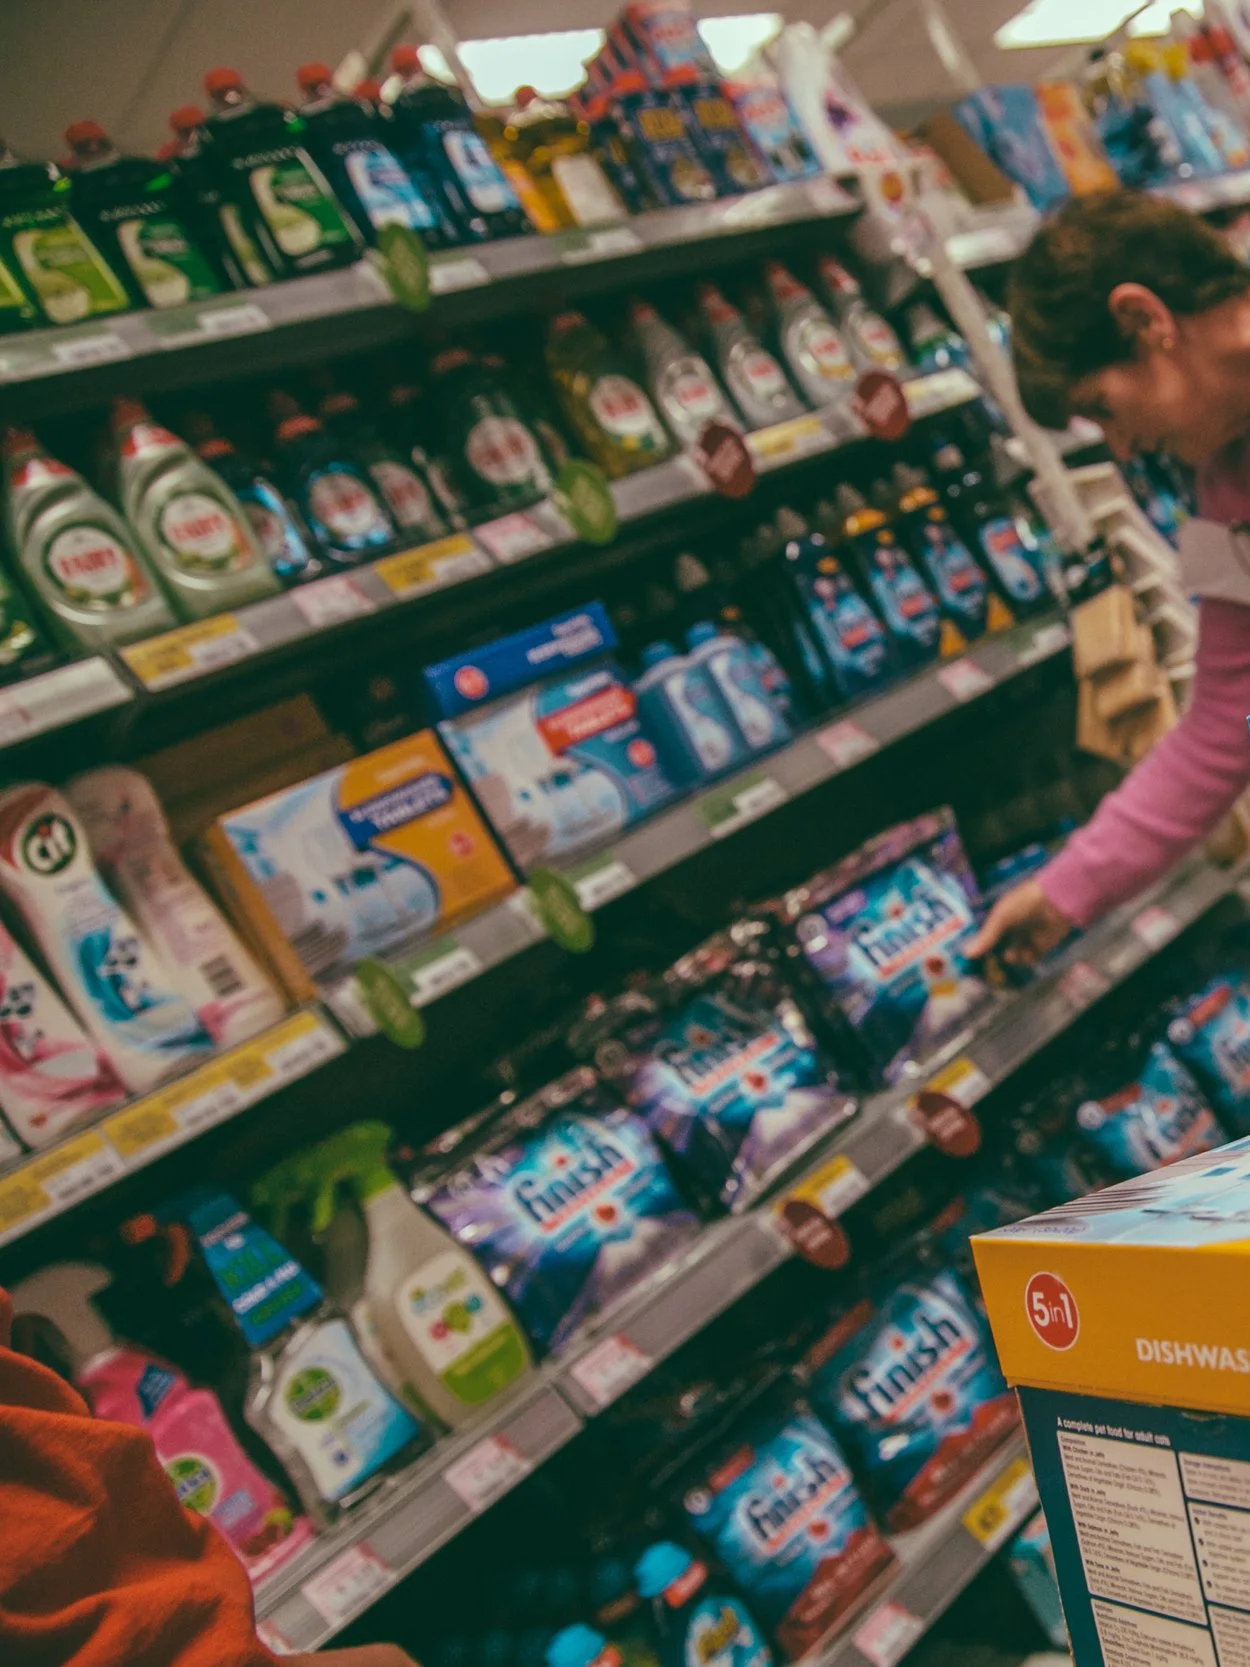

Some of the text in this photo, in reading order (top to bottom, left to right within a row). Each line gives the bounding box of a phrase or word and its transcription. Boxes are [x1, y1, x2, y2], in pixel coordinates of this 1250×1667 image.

[515, 1138, 626, 1222] finish
[1031, 1290, 1074, 1329] 5in1
[850, 1313, 962, 1420] finish
[1063, 1419, 1094, 1433] complete
[1106, 1424, 1123, 1438] food
[1123, 1427, 1134, 1440] for
[1135, 1429, 1154, 1443] adult
[1154, 1433, 1171, 1447] cats
